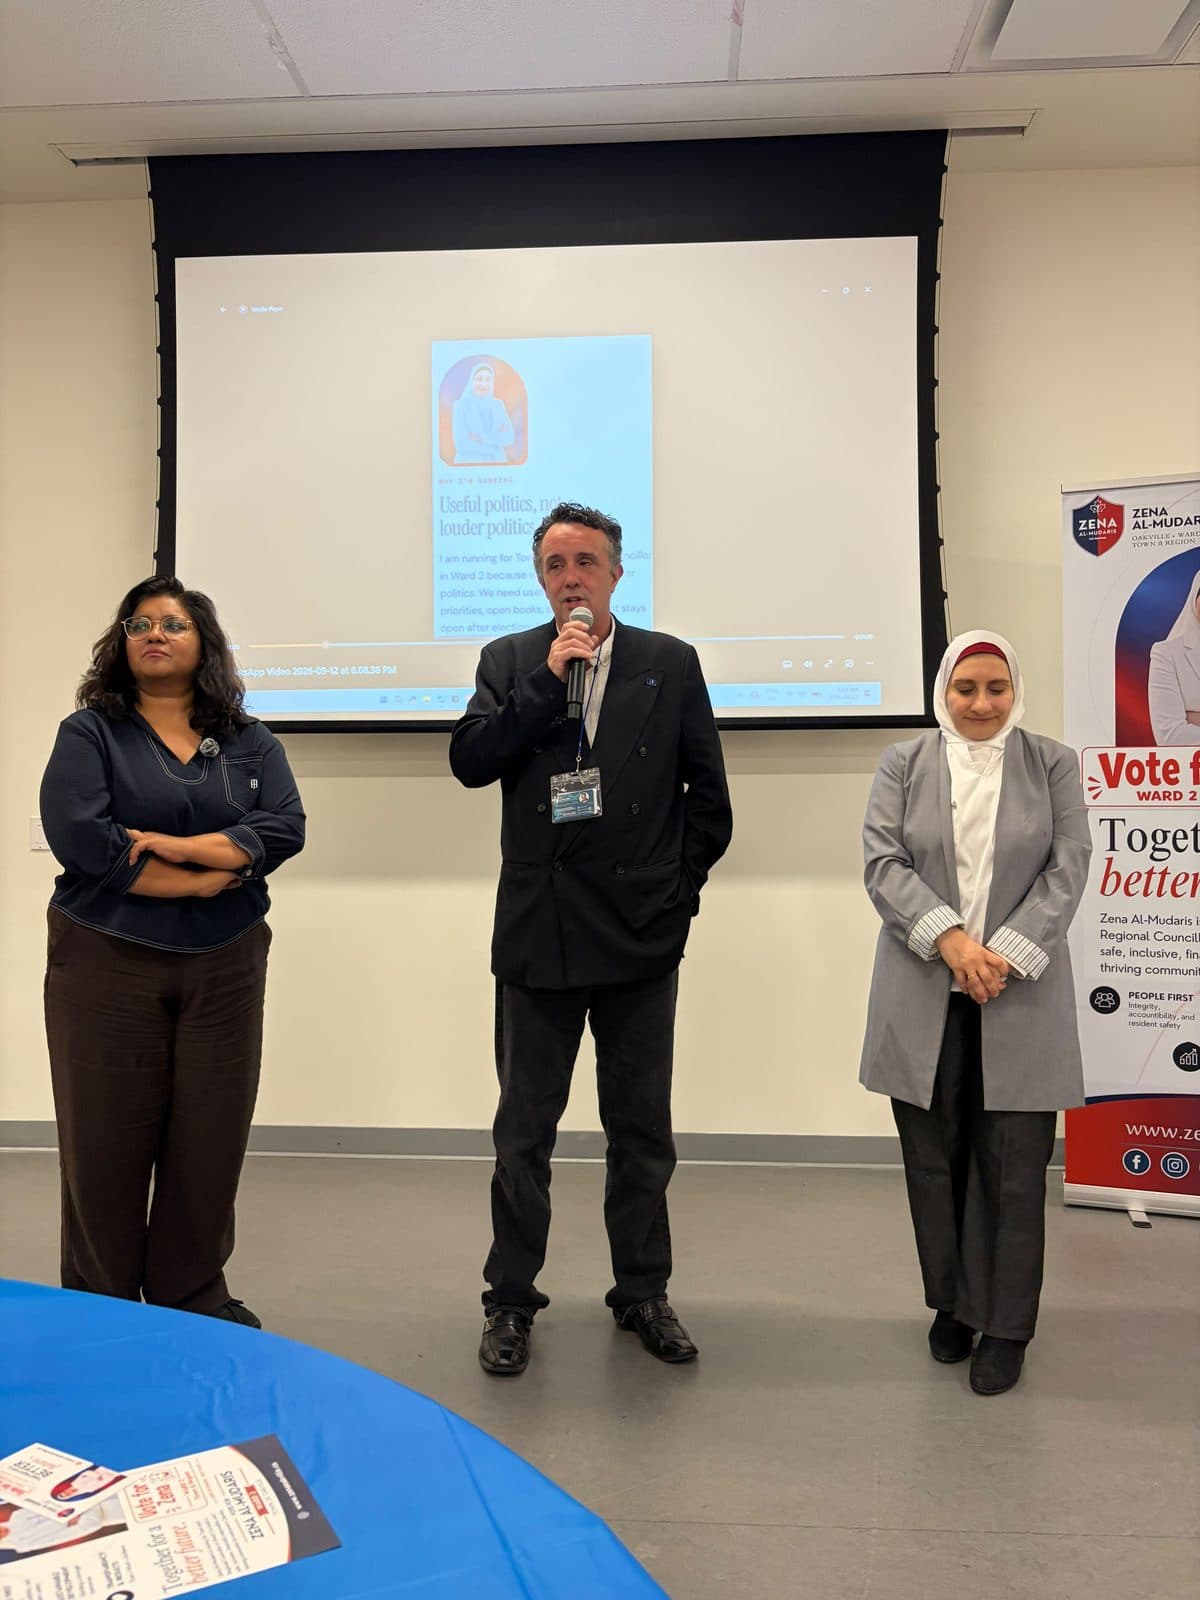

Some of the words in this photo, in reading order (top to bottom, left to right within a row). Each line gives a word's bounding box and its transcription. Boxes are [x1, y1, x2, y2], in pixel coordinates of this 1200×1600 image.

[440, 495, 481, 513] Useful
[485, 495, 537, 516] politics,
[1132, 507, 1168, 518] ZENA
[440, 518, 485, 536] louder
[1078, 517, 1118, 530] ZENA
[1132, 515, 1200, 530] AL-MUDAR
[1079, 529, 1117, 537] AL-MUDARIS
[1132, 533, 1170, 541] OAKVILLE
[1165, 538, 1196, 546] REGION
[445, 555, 460, 563] am
[462, 553, 497, 565] running
[500, 553, 513, 562] for
[440, 573, 448, 581] in
[450, 571, 476, 581] Ward
[477, 571, 485, 580] 2
[486, 571, 527, 580] because
[479, 588, 495, 597] We
[496, 587, 521, 597] need
[440, 604, 485, 616] priorities,
[486, 605, 512, 616] open
[441, 623, 465, 634] open
[467, 622, 489, 632] after
[267, 667, 291, 676] Video
[383, 665, 397, 674] PM
[1097, 751, 1180, 789] Vote
[1136, 790, 1183, 801] WARD
[1189, 790, 1198, 801] 2
[1099, 818, 1200, 862] Toget
[1100, 913, 1128, 924] Zena
[1131, 914, 1193, 926] Al-Mudaris
[1100, 929, 1150, 943] Regional
[1100, 946, 1126, 958] safe,
[1129, 947, 1182, 960] inclusive,
[1186, 948, 1200, 959] fin
[1100, 963, 1142, 976] thriving
[1128, 991, 1165, 1001] PEOPLE
[1167, 993, 1194, 1002] FIRST
[1128, 1002, 1161, 1010] Integrity,
[1159, 1021, 1181, 1030] safety
[1125, 1123, 1200, 1141] www.ze
[156, 1484, 176, 1506] Zena
[242, 1517, 264, 1541] ZENA
[154, 1549, 184, 1593] Together
[184, 1555, 208, 1586] better
